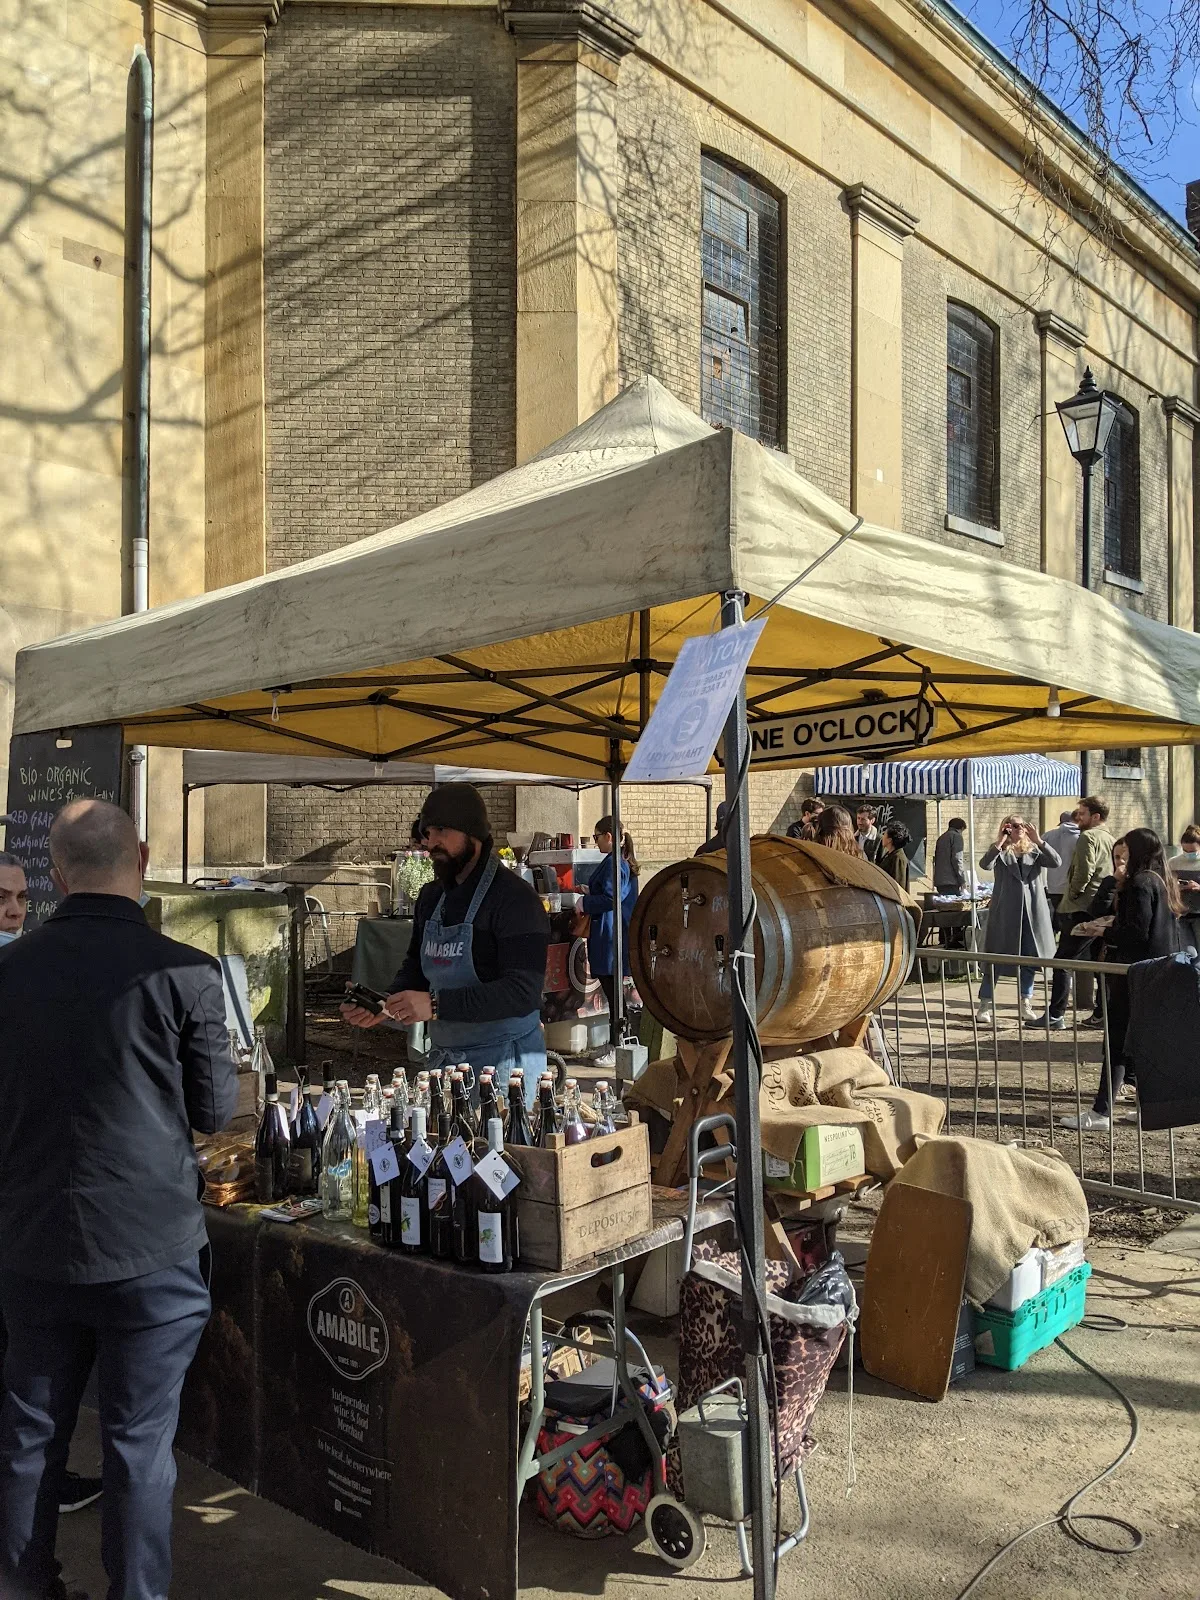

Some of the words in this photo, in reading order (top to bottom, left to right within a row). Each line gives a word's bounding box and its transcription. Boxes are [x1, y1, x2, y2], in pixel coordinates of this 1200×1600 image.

[793, 707, 919, 746] O'CLOCK
[11, 810, 28, 824] RED
[424, 941, 464, 957] AMABILE
[578, 1209, 625, 1239] DEPOSIT
[317, 1310, 380, 1354] AMABILE
[331, 1388, 370, 1416] Independent
[333, 1403, 350, 1418] wine
[337, 1418, 363, 1443] Merchant
[352, 1460, 392, 1481] everywhere
